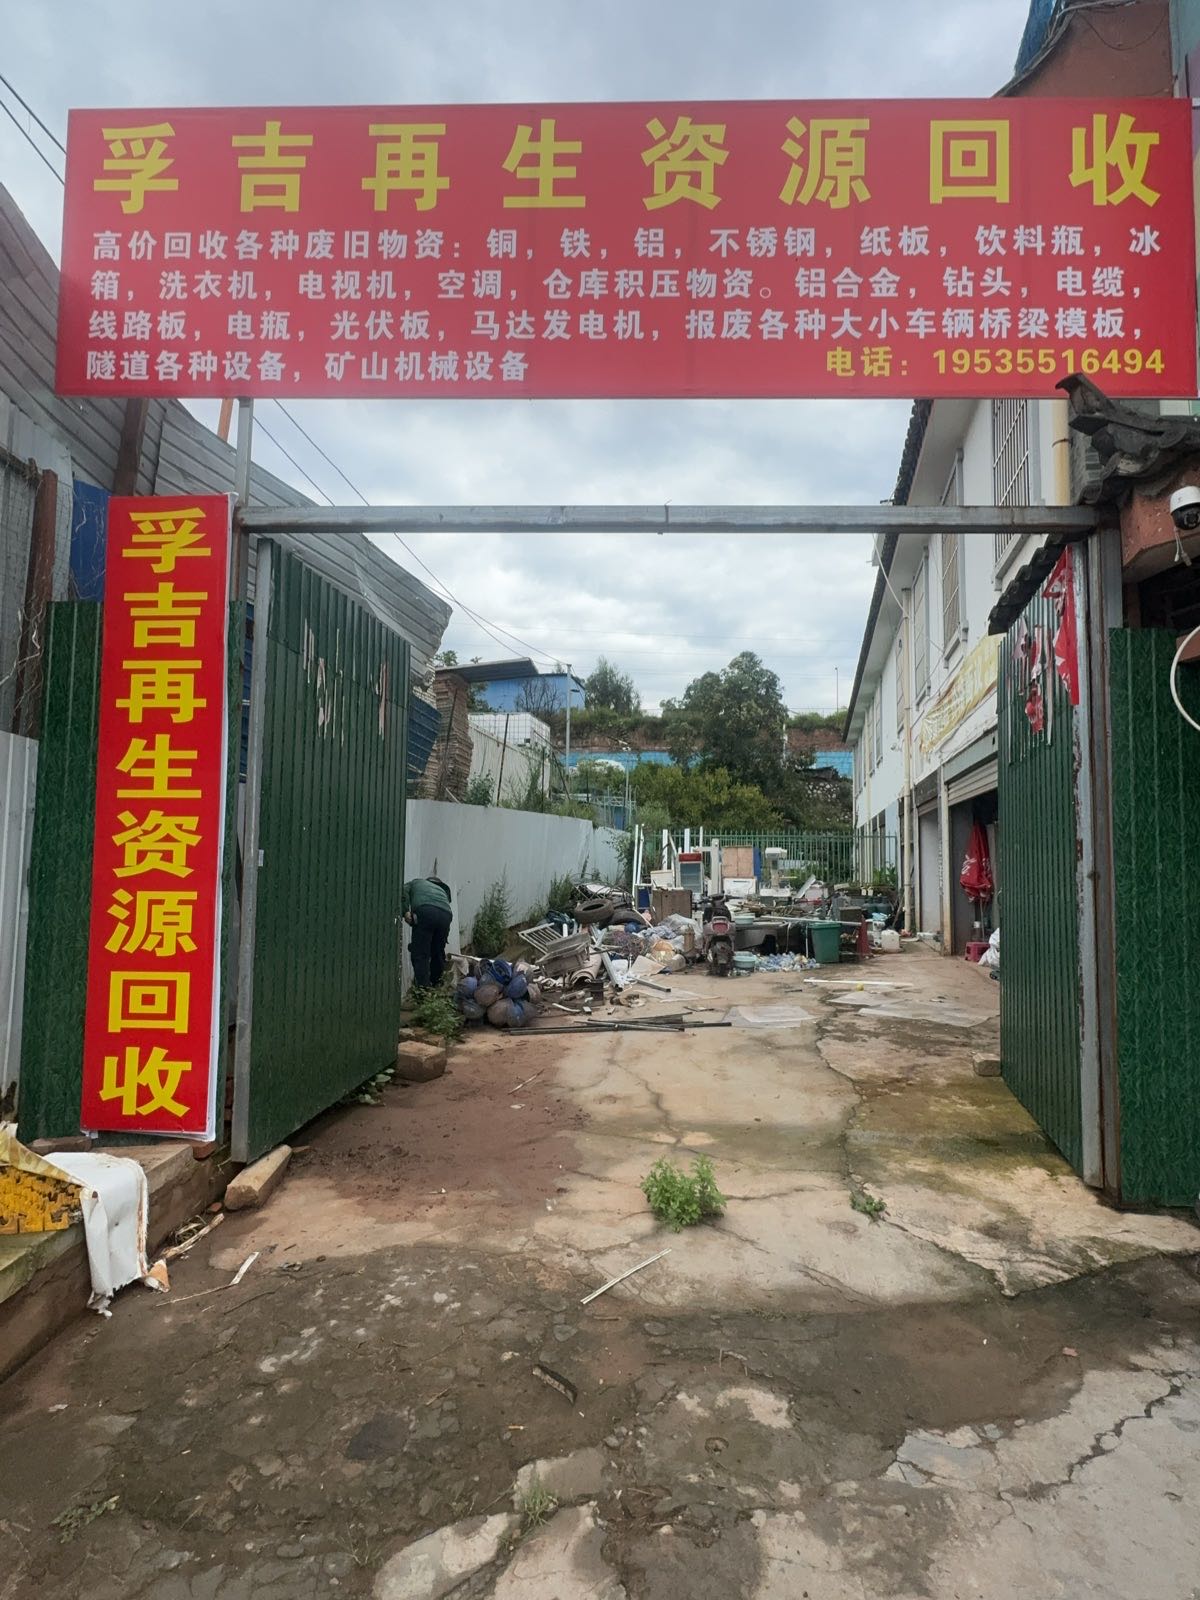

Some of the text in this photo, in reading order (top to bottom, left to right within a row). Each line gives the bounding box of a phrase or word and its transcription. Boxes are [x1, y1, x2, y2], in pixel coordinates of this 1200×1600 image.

[94, 114, 1160, 213] 孚吉再生资源回收
[86, 351, 529, 382] 隧道各种设备，矿山机械设备
[99, 507, 211, 1118] 孚吉再生资源回收
